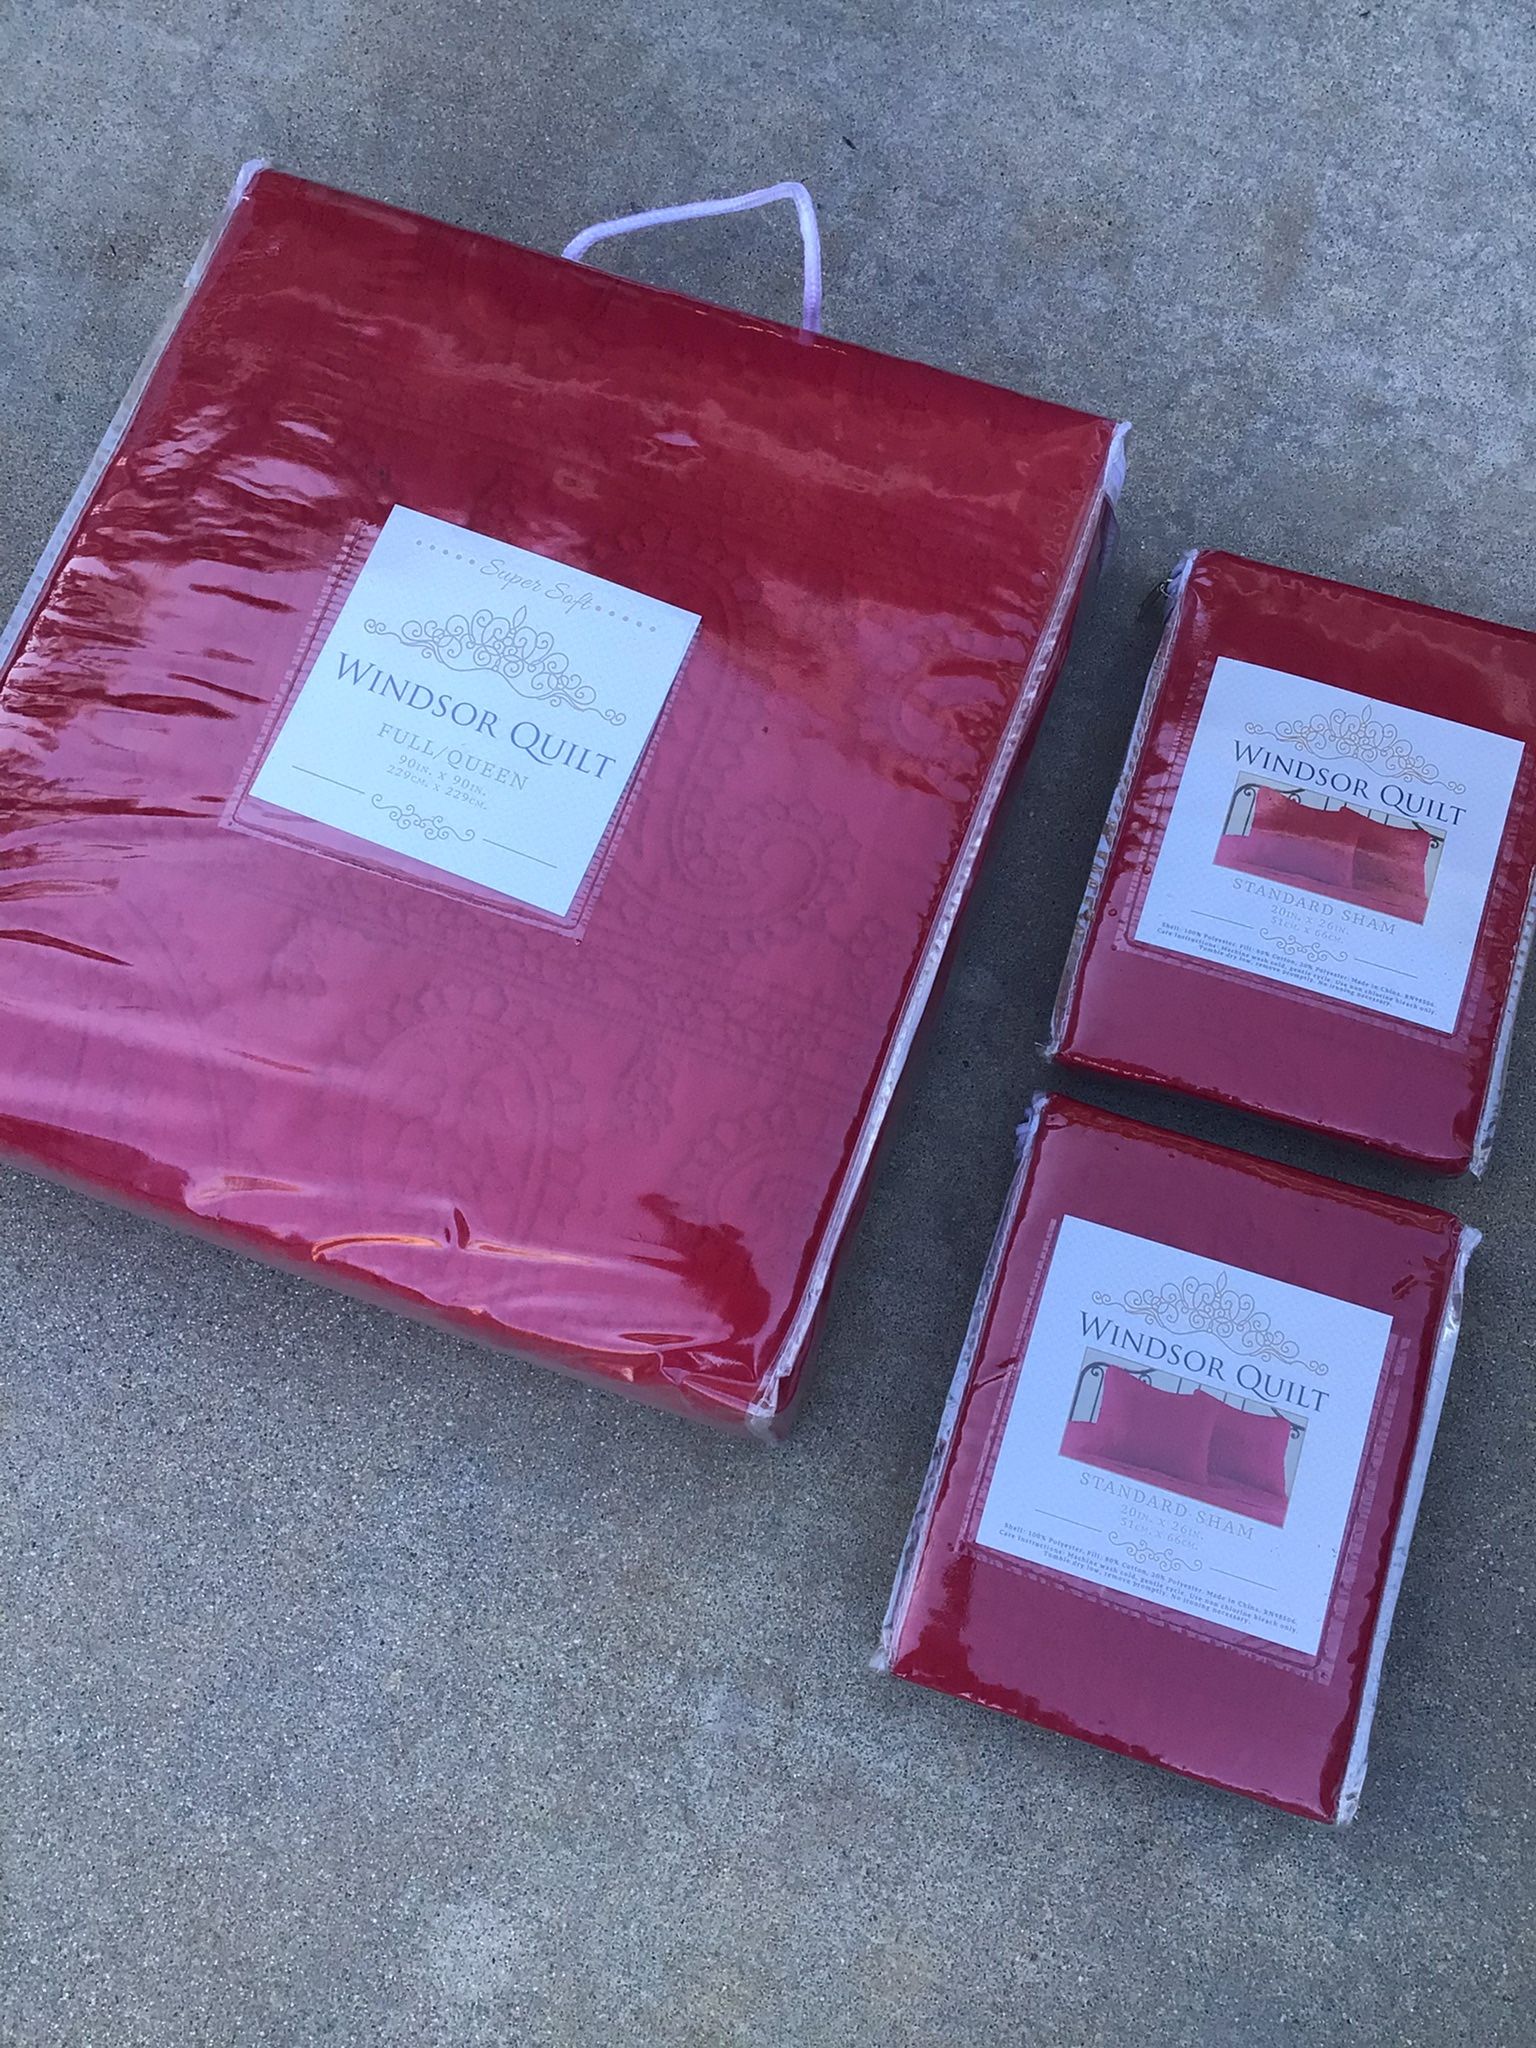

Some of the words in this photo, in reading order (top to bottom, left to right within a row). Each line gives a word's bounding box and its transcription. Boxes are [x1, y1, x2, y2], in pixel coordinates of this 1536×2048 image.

[479, 558, 542, 592] Super
[543, 582, 593, 615] Soft
[336, 650, 501, 739] WINDSOR
[509, 720, 617, 780] QUILT
[376, 721, 529, 791] FULL/QUEEN
[1233, 738, 1370, 801] WINDSOR
[1379, 783, 1467, 826] QUILT
[1232, 877, 1334, 916] STANDARD
[1340, 909, 1396, 936] SHAM
[1079, 1309, 1226, 1382] WINDSOR
[1235, 1363, 1330, 1413] QUILT
[1079, 1471, 1188, 1517] STANDARD
[1195, 1510, 1254, 1540] SHAM
